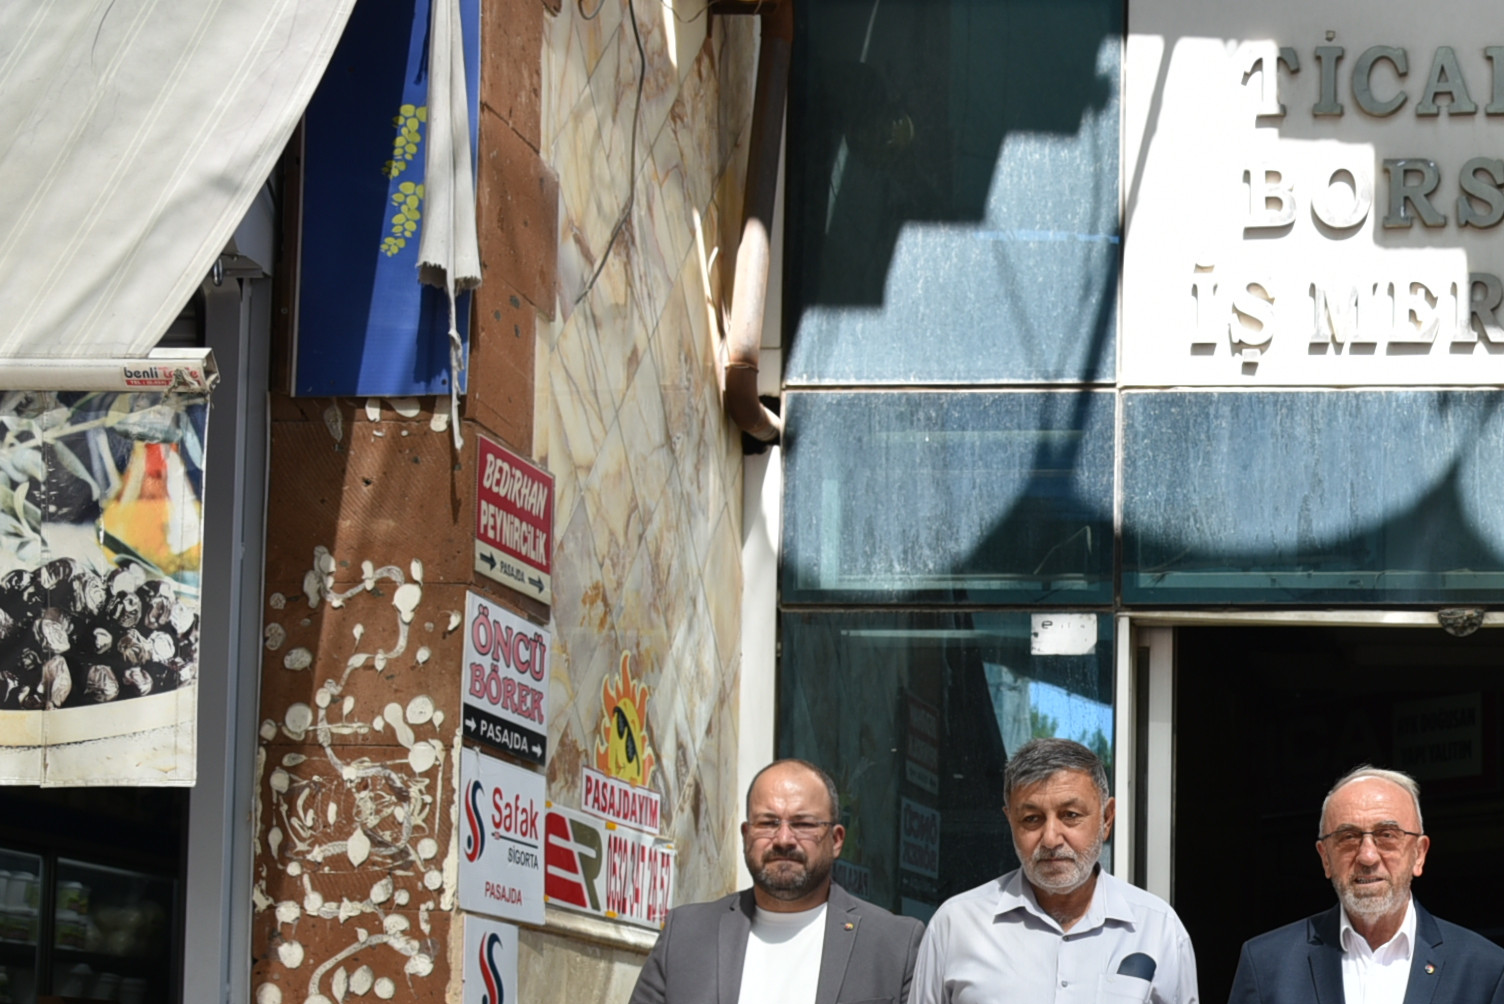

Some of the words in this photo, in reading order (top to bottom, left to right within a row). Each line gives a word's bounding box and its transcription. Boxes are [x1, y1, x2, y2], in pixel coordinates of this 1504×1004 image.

[1190, 251, 1276, 375] İŞ
[472, 604, 546, 682] ÖNCÜ
[469, 663, 544, 725] BÖREK
[480, 719, 529, 753] PASAJDA
[585, 775, 658, 829] PASAJDAYIM
[507, 846, 539, 870] SİGORTA
[485, 881, 522, 905] PASAJDA
